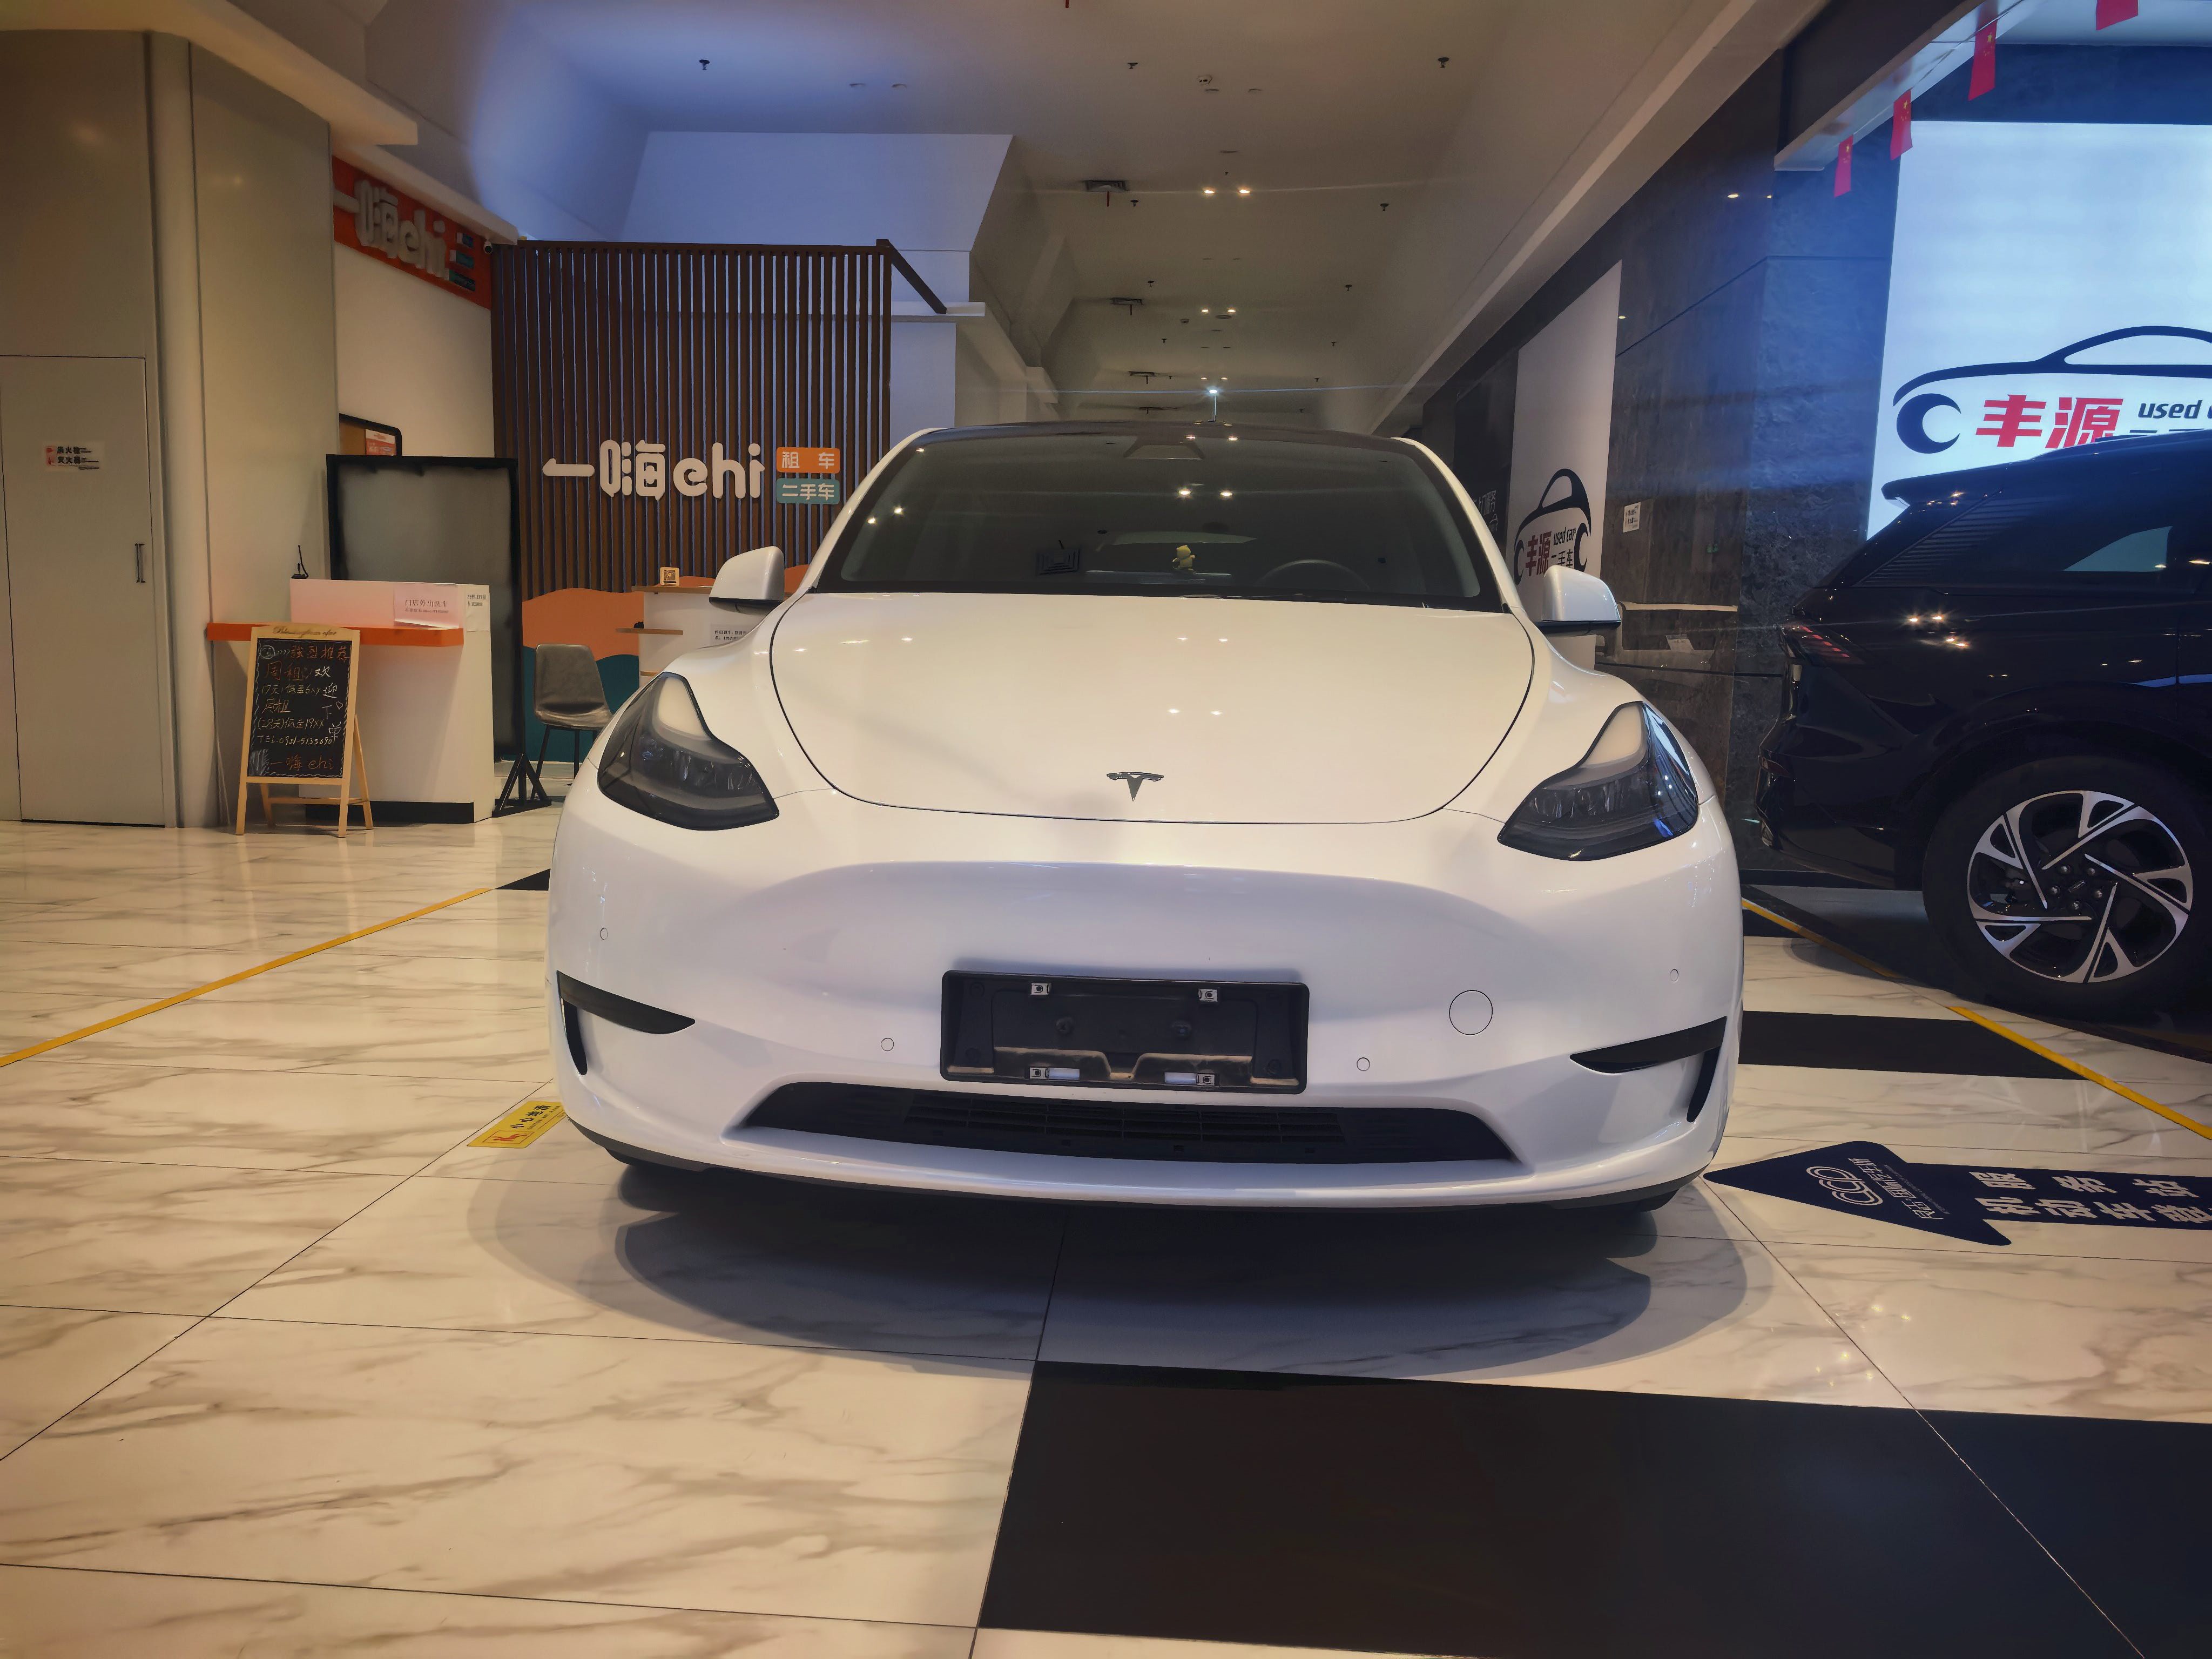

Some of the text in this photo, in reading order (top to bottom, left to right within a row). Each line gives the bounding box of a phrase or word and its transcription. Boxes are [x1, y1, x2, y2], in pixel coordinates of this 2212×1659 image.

[2138, 400, 2203, 419] used
[1975, 394, 2123, 449] 丰源
[781, 451, 835, 469] 租车
[781, 483, 835, 501] 二手车
[1553, 527, 1576, 545] used car
[1525, 531, 1552, 576] 丰源
[1975, 1196, 2212, 1224] 机动车登
